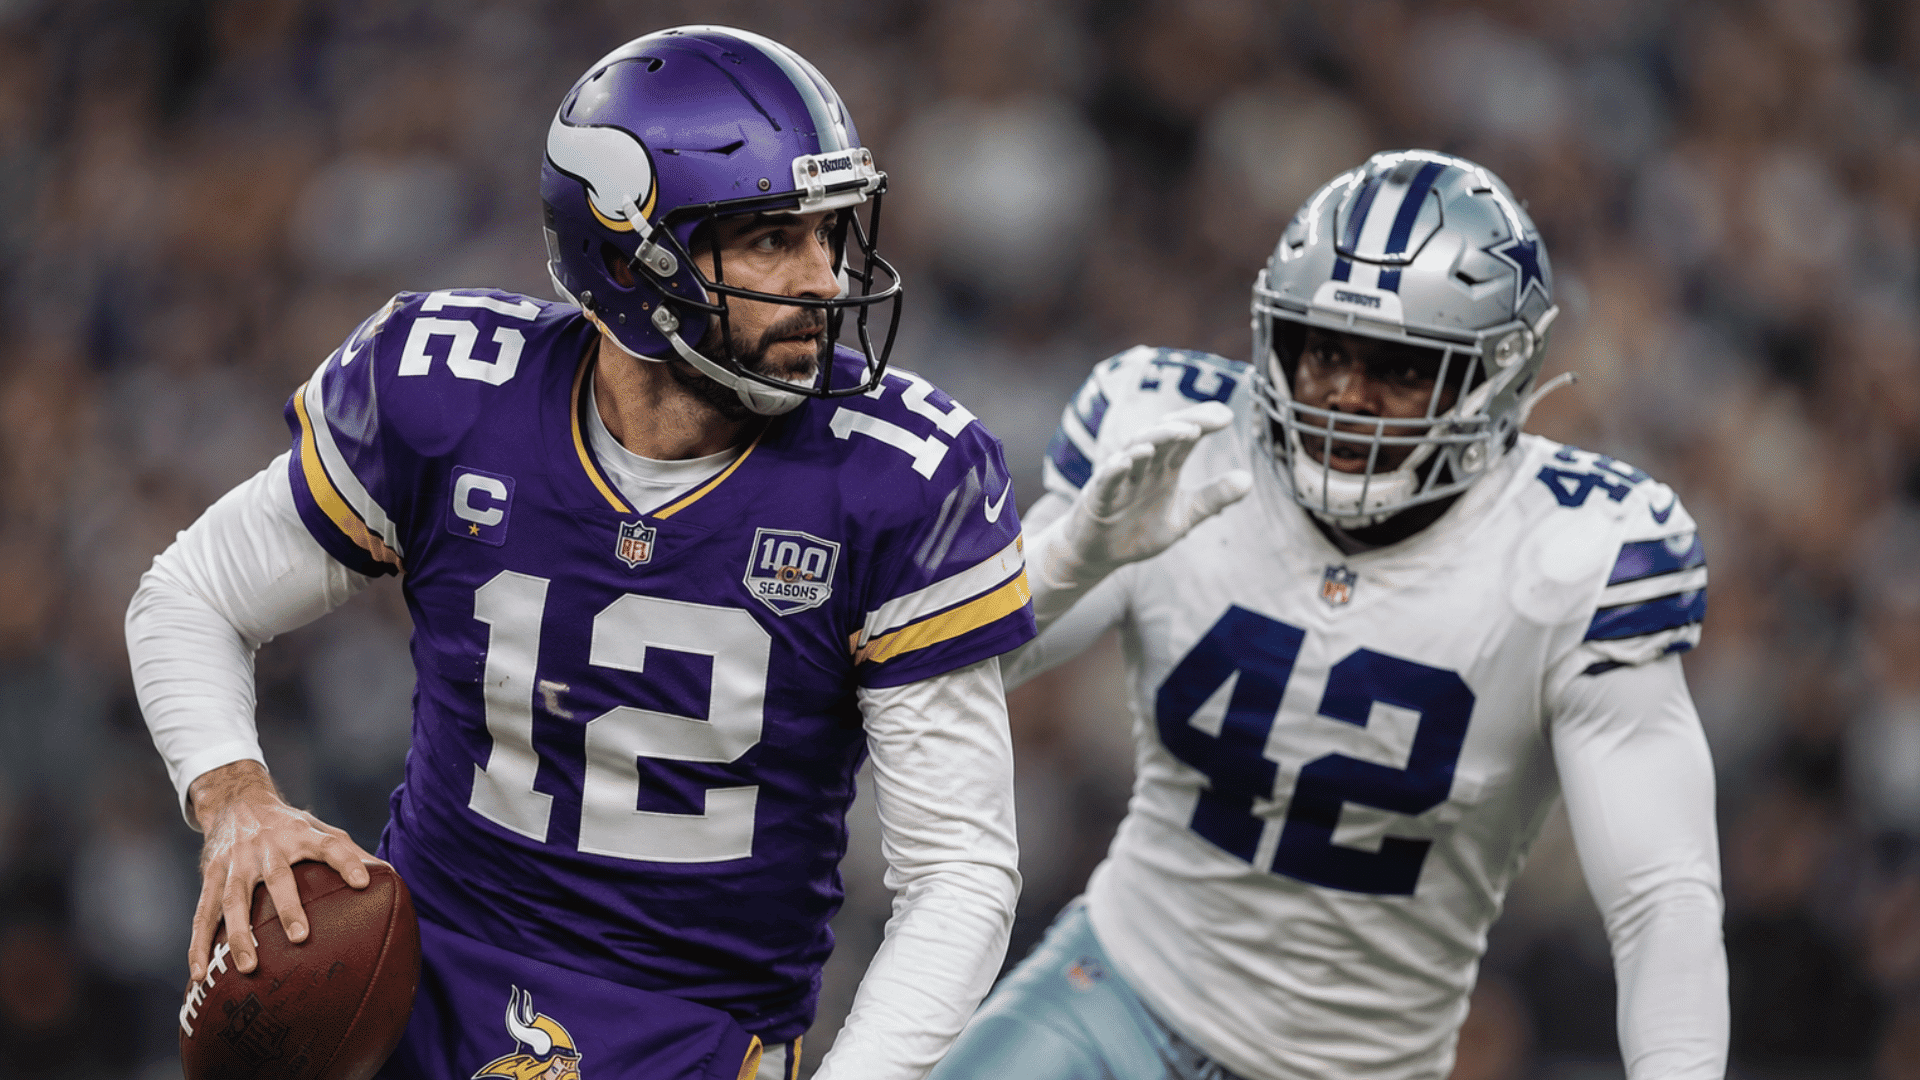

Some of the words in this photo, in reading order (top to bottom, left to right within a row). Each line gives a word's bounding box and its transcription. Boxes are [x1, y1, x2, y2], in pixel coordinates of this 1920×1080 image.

[398, 291, 541, 386] 12
[829, 366, 977, 481] 12
[453, 473, 507, 526] C
[759, 581, 818, 600] SEASONS
[760, 538, 827, 578] 100
[468, 570, 771, 863] 12
[1155, 602, 1476, 897] 42
